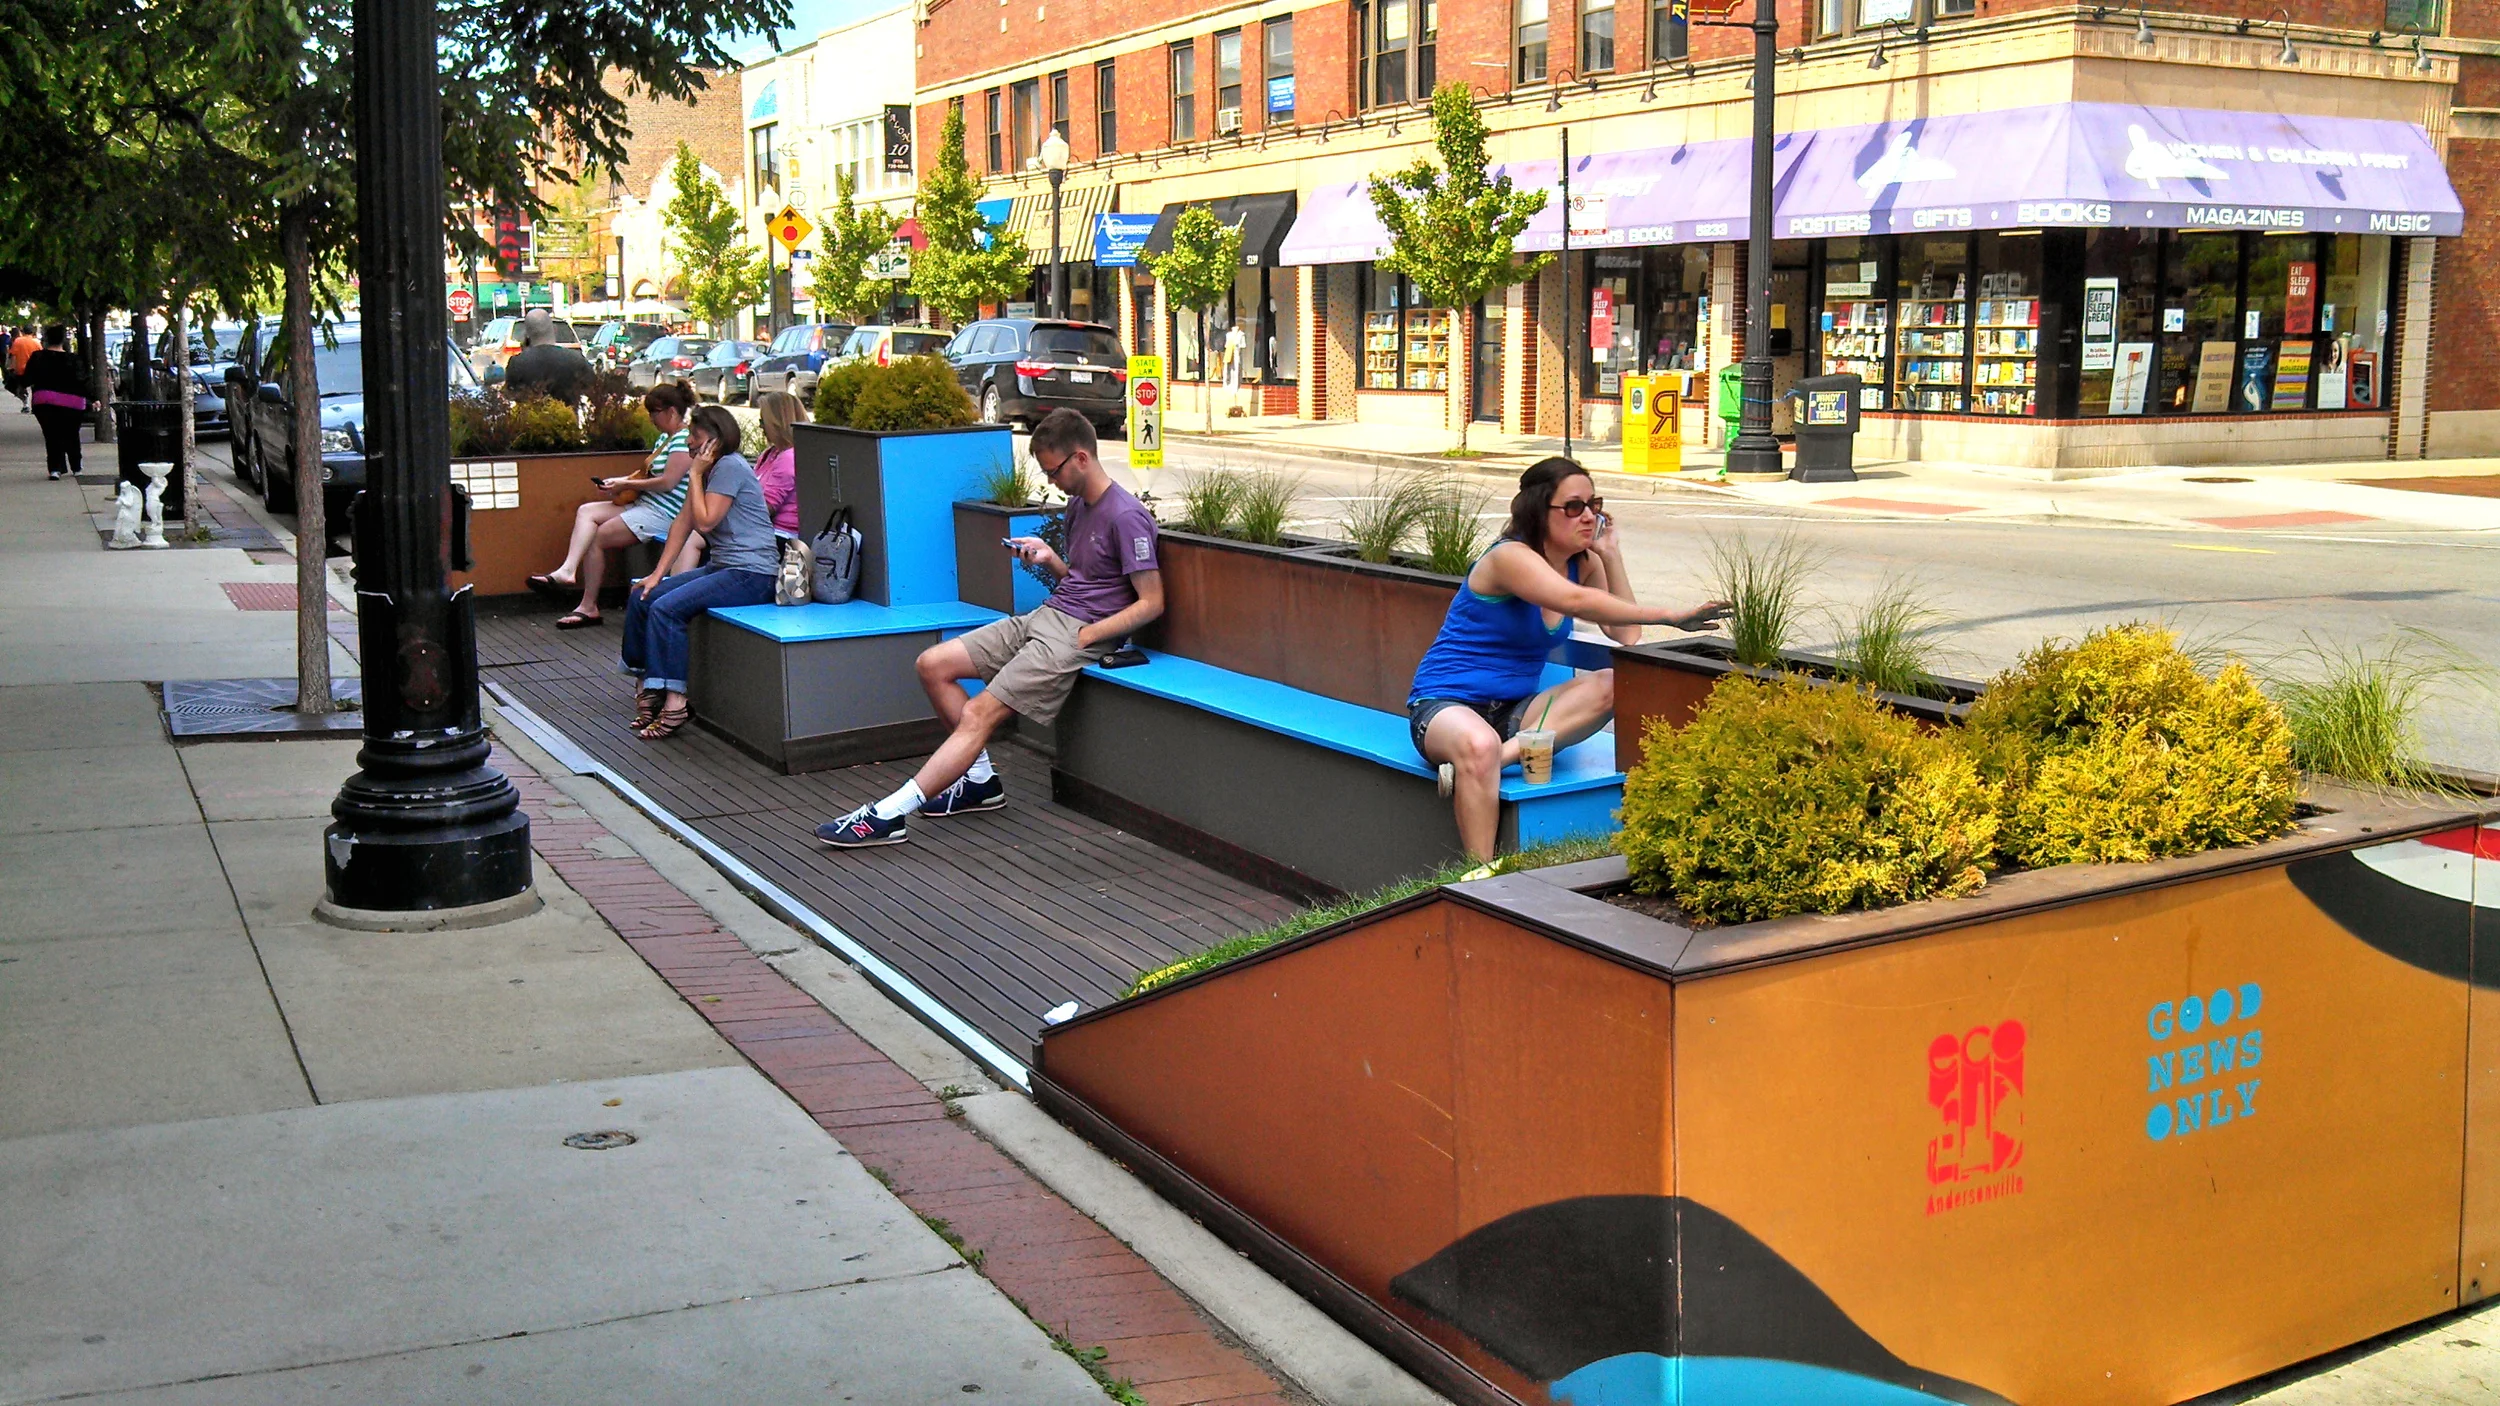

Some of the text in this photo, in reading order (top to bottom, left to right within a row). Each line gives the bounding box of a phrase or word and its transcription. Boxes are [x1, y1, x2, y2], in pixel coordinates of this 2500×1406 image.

[885, 107, 911, 143] SALON
[888, 144, 909, 156] 10
[2165, 142, 2408, 170] WOMEN & CHILDREN FIRST
[1789, 203, 2431, 235] POSTERS GIFTS BOOKS MAGAZINES MUSIC
[2290, 266, 2303, 276] EAT
[2290, 277, 2311, 286] SLEEP
[2290, 286, 2307, 296] READ
[449, 297, 472, 307] STOP
[2089, 292, 2104, 303] EAT
[2088, 302, 2112, 313] SLEEP
[1135, 359, 1156, 368] STATE
[1139, 367, 1153, 375] LAW
[1136, 388, 1157, 399] STOP
[1816, 393, 1841, 403] WINDY
[1817, 402, 1837, 412] CITY
[1816, 410, 1839, 420] TIMES
[2147, 981, 2263, 1041] GOOD
[2147, 1029, 2263, 1092] NEWS
[2145, 1079, 2261, 1142] ONLY
[1926, 1173, 2025, 1217] Andersonville
